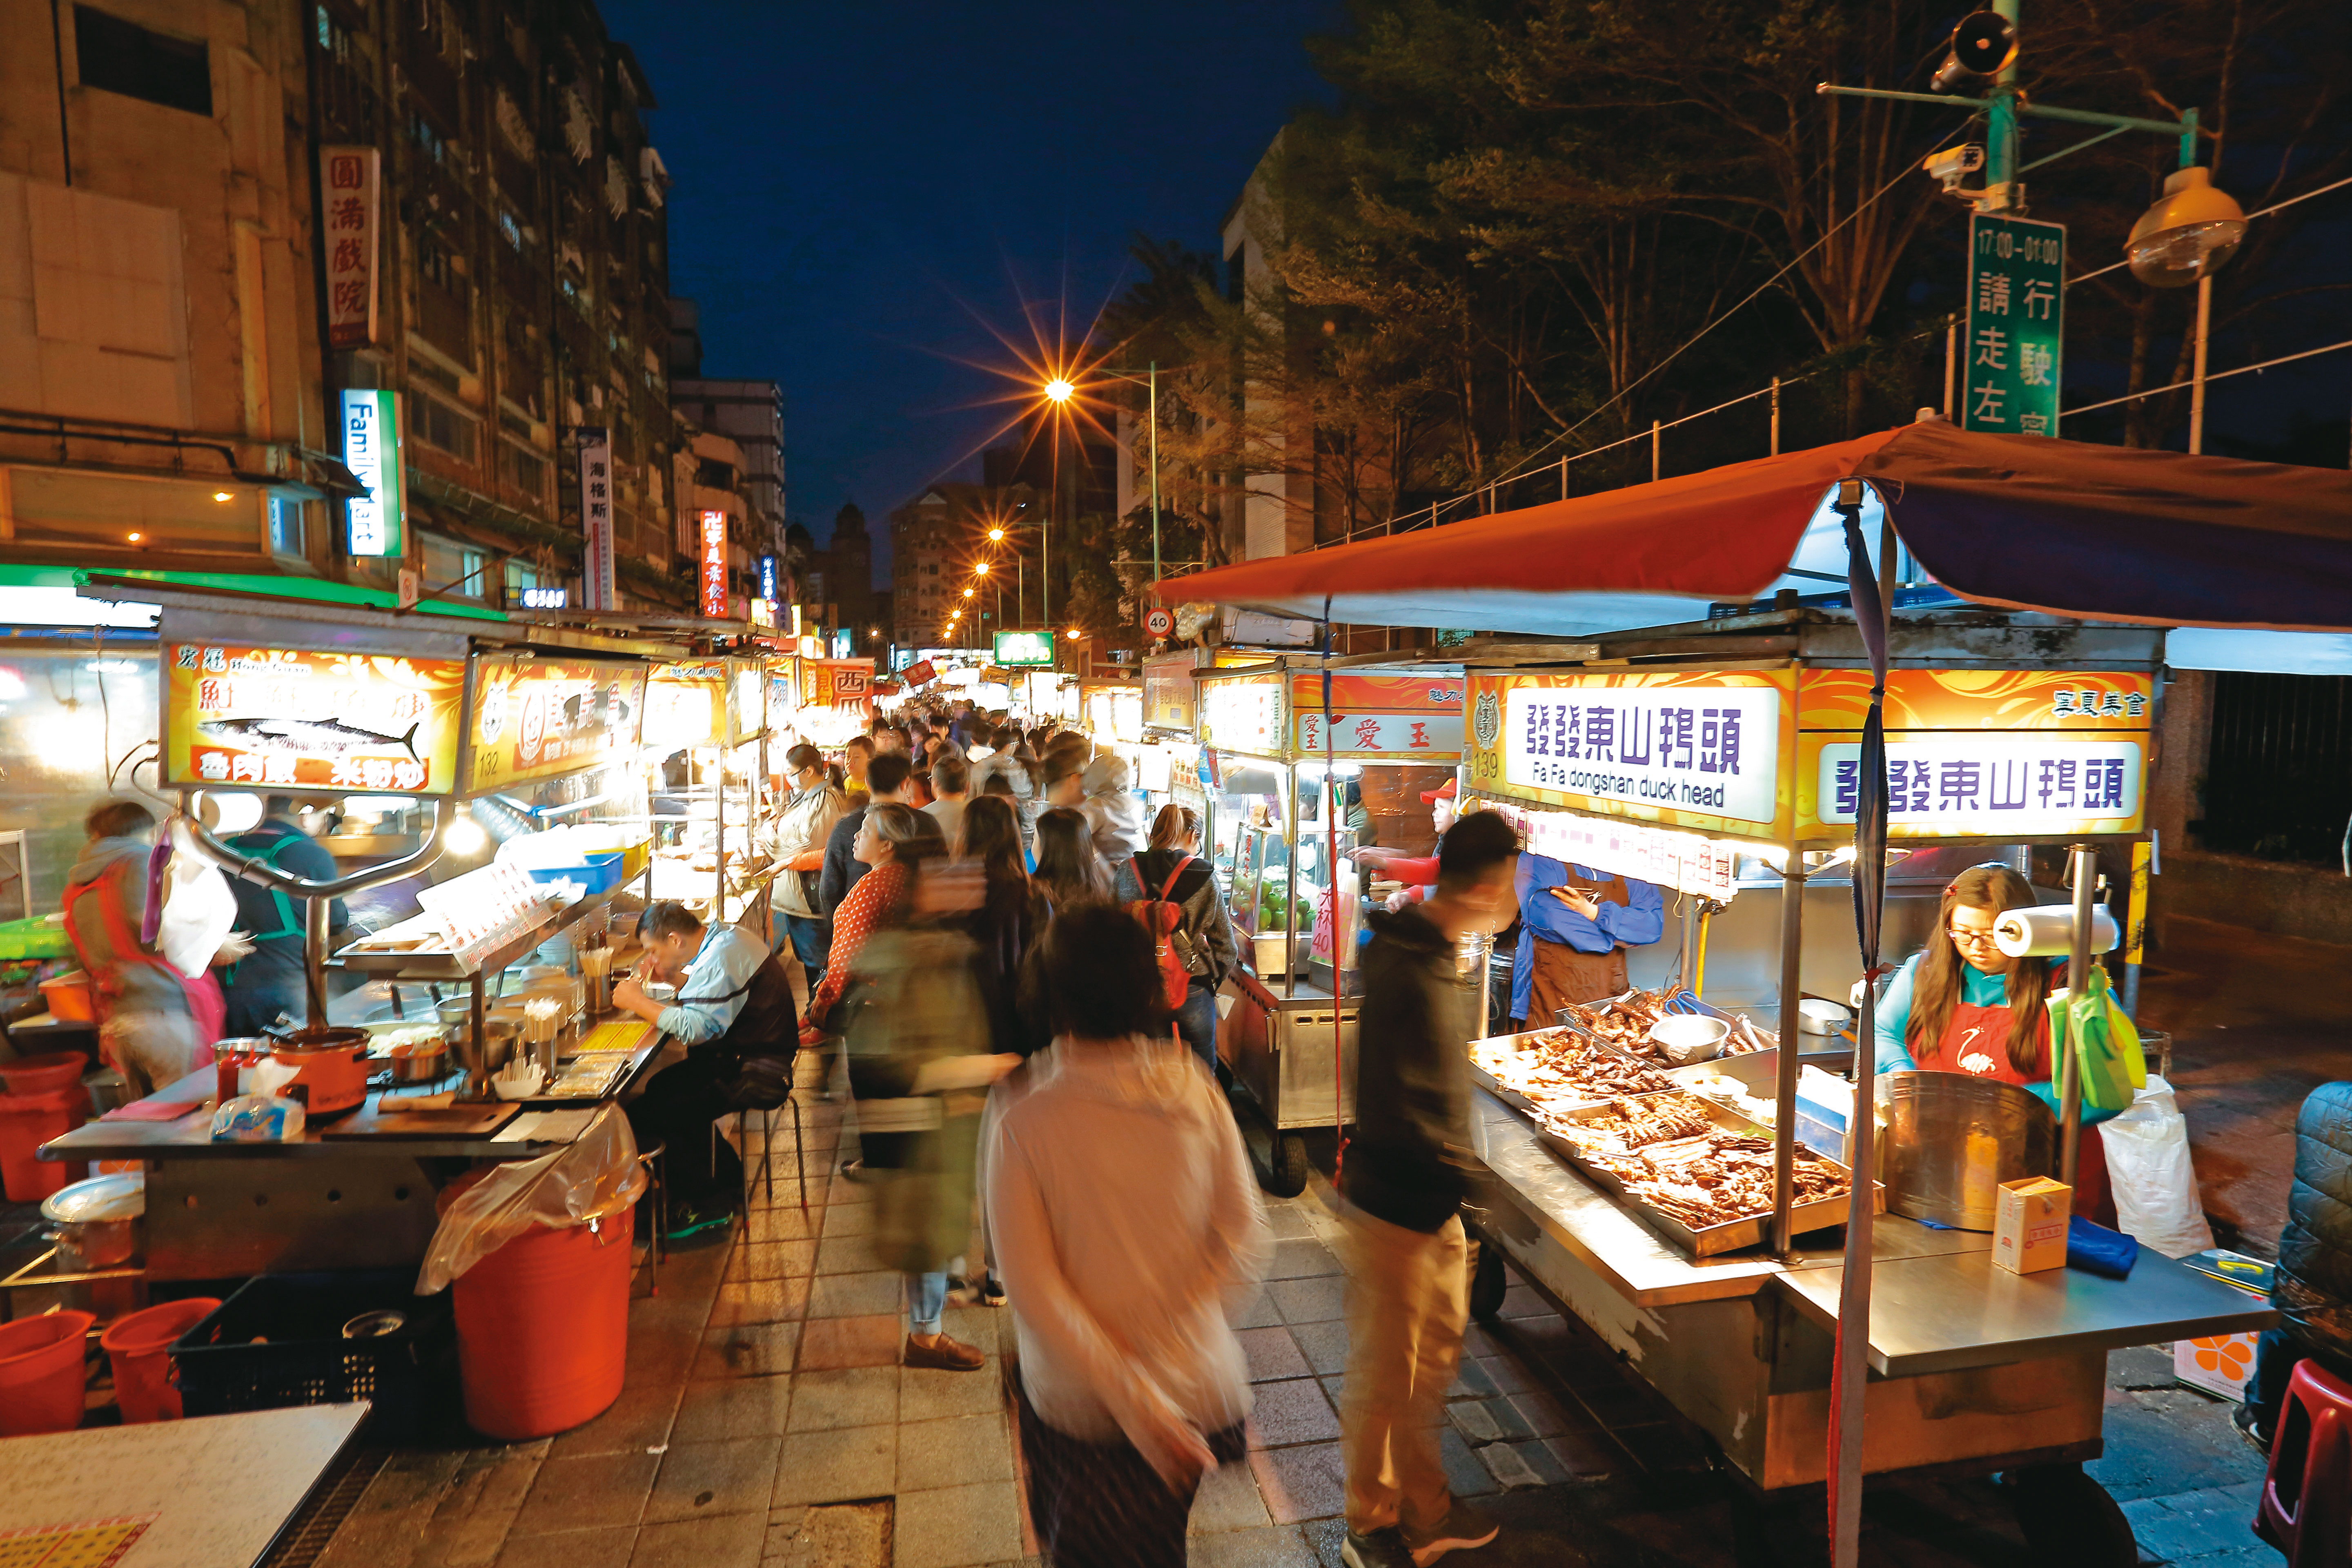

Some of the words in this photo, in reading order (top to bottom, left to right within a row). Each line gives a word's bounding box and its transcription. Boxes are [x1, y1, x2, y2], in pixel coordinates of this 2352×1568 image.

[1149, 617, 1167, 628] 40
[835, 670, 869, 720] 西瓜
[1304, 715, 1320, 750] 愛玉
[1354, 718, 1430, 750] 愛玉
[479, 751, 498, 777] 132
[1474, 752, 1497, 778] 139
[1533, 761, 1546, 782] Fa
[1551, 763, 1566, 785] Fa
[1570, 766, 1634, 795] dongshan
[1639, 775, 1677, 801] duck
[1681, 778, 1724, 808] head
[1312, 933, 1328, 953] 40
